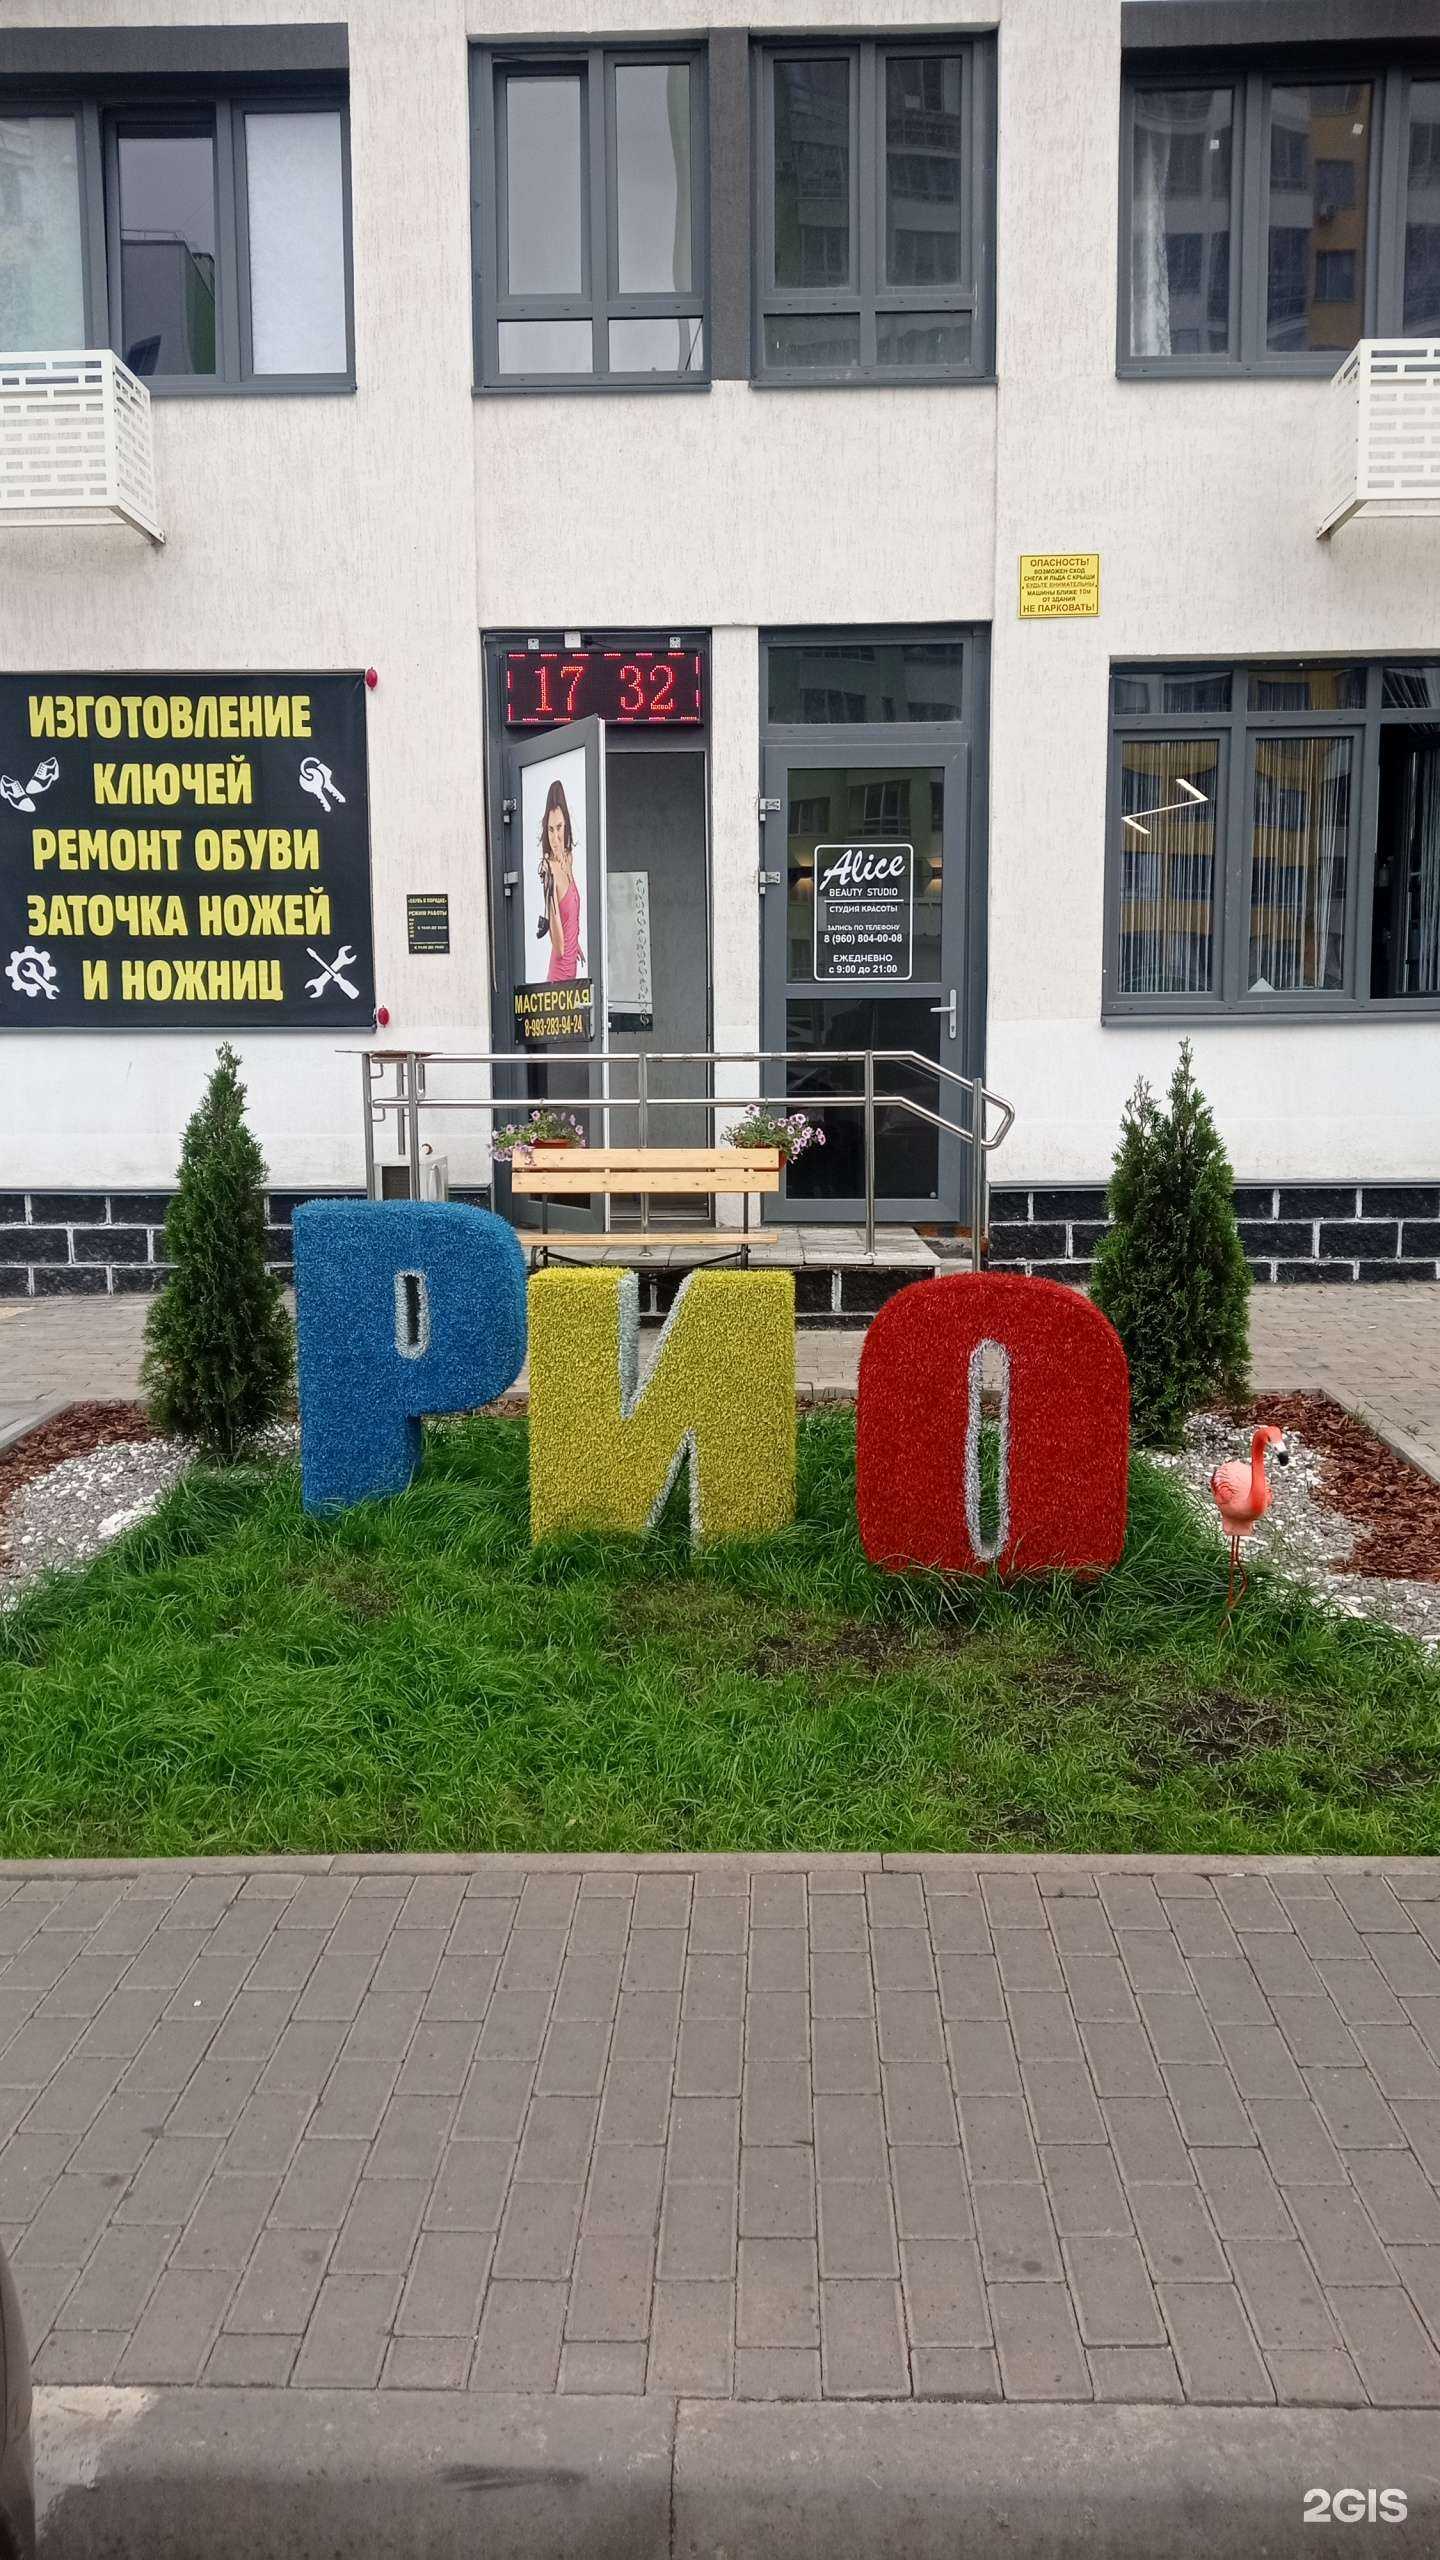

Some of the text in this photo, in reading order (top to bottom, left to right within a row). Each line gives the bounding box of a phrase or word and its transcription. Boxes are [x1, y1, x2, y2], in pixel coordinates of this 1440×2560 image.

[1030, 558, 1090, 567] ОПАСНОСТЬ!
[1038, 604, 1095, 612] ПАРКОВАТЬ!
[534, 665, 674, 711] 17 32
[29, 695, 311, 738] ИЗГОТОВЛЕНИЕ
[93, 754, 252, 804] КЛЮЧЕЙ
[32, 829, 320, 870] РЕМОНТ ОБУВИ
[820, 849, 905, 890] Alice
[27, 887, 331, 936] ЗАТОЧКА НОЖЕЙ
[829, 888, 898, 896] BEAUTY STUDIO
[824, 934, 902, 945] 8 (960) 804-00-08
[833, 954, 893, 962] ЕЖЕДНЕВНО
[83, 960, 283, 1001] И НОЖНИЦ
[836, 965, 856, 973] 9:00
[858, 966, 870, 974] до
[872, 964, 898, 973] 21:00
[514, 988, 590, 1014] МАСТЕРСКАЯ
[292, 1198, 1131, 1580] РИО
